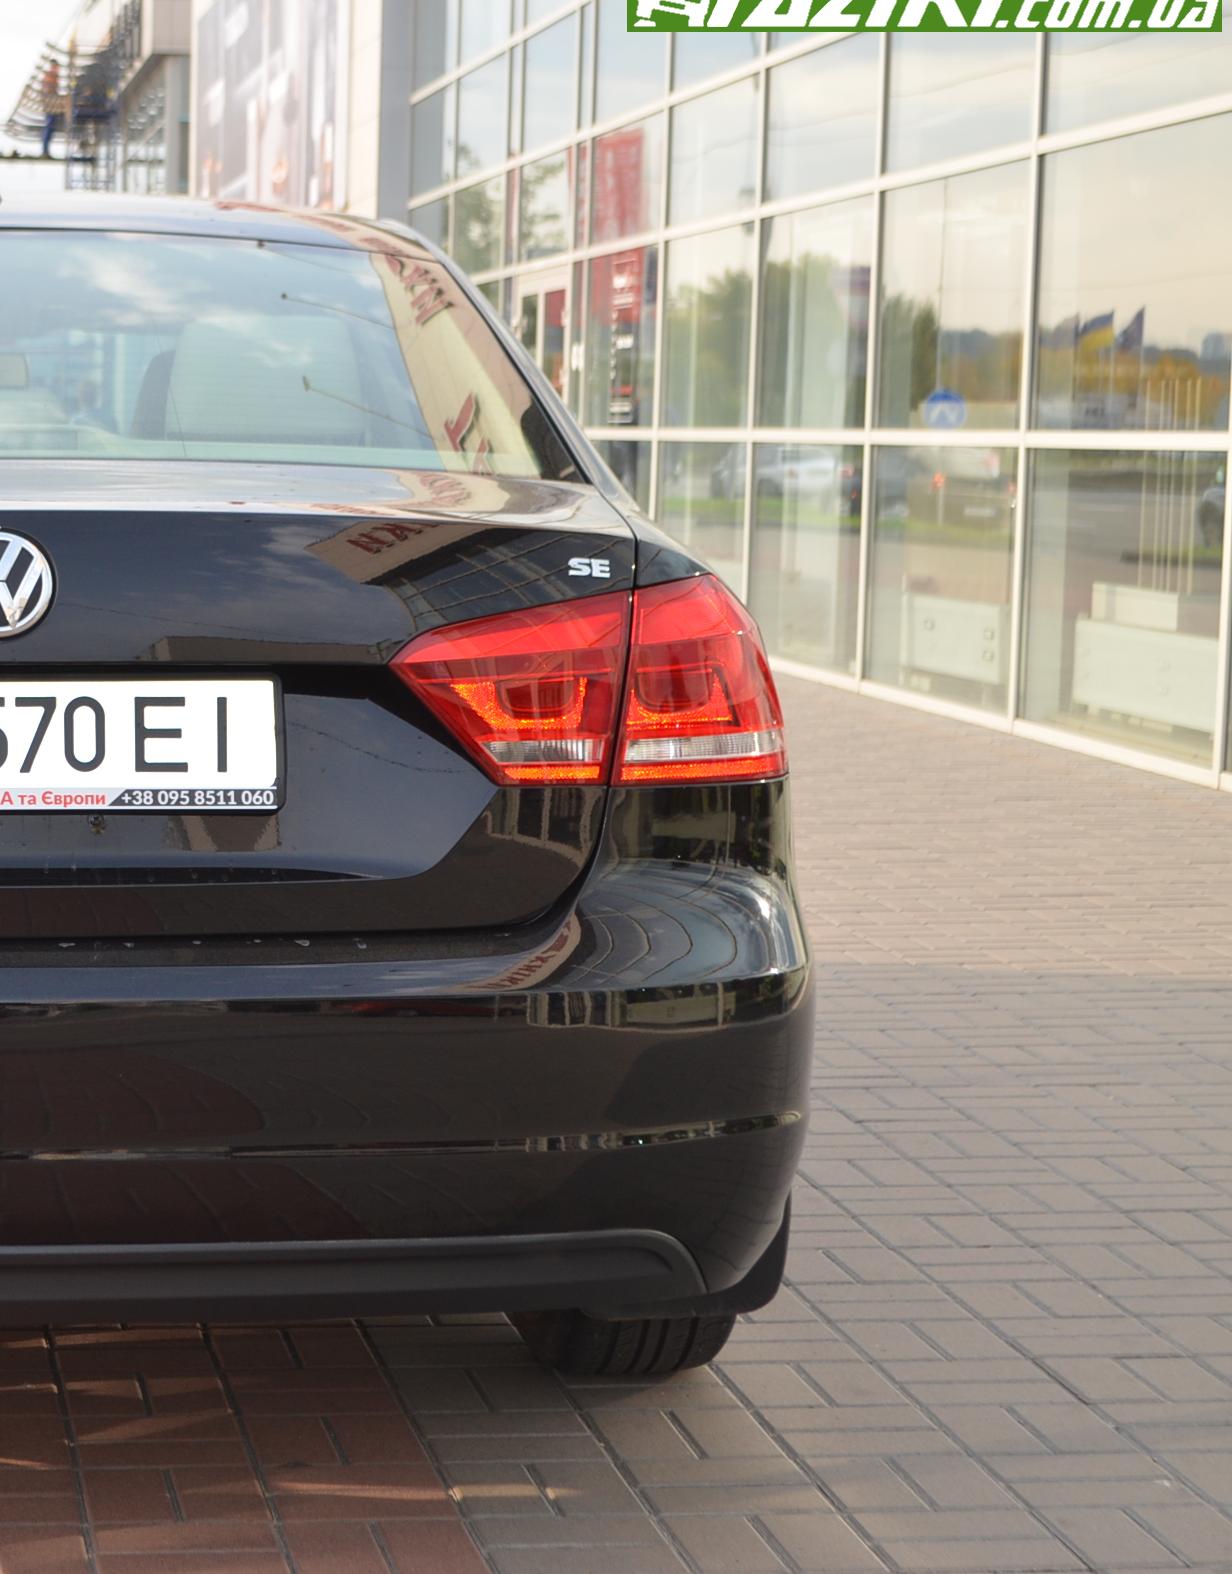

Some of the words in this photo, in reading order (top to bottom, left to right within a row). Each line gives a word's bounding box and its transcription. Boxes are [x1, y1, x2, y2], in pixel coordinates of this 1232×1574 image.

[567, 557, 611, 578] SE
[134, 696, 228, 773] EI
[17, 794, 37, 806] та
[41, 790, 106, 808] Європи
[121, 790, 154, 805] +38
[157, 790, 190, 805] 095
[194, 790, 237, 805] 8511
[241, 790, 274, 805] 060
